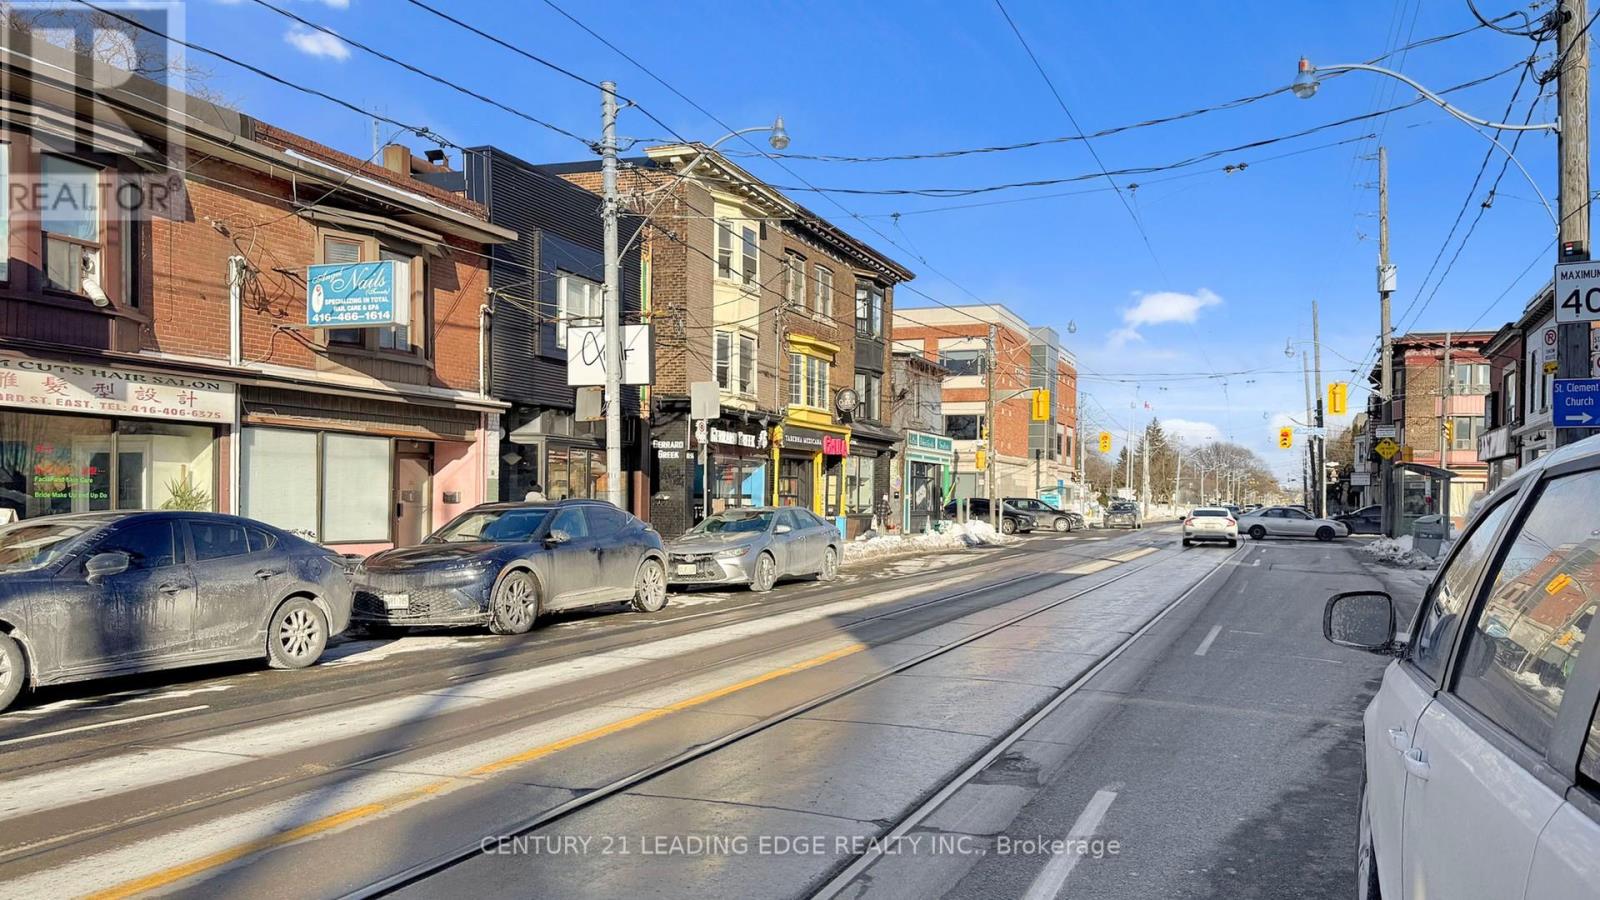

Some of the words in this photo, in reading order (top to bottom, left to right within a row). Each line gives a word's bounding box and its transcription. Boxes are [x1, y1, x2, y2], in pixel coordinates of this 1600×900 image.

[331, 267, 386, 293] Nails
[1561, 287, 1600, 315] 40
[312, 311, 390, 322] 416-466-1614
[18, 361, 85, 376] CUTS
[90, 369, 146, 382] HAIR
[152, 376, 220, 390] SALON
[1555, 383, 1565, 392] St.
[1566, 382, 1599, 393] Clement
[30, 395, 52, 405] ST.
[56, 398, 94, 408] EAST.
[100, 402, 127, 411] TEL:
[1565, 396, 1594, 406] Church
[658, 450, 679, 459] GREEK
